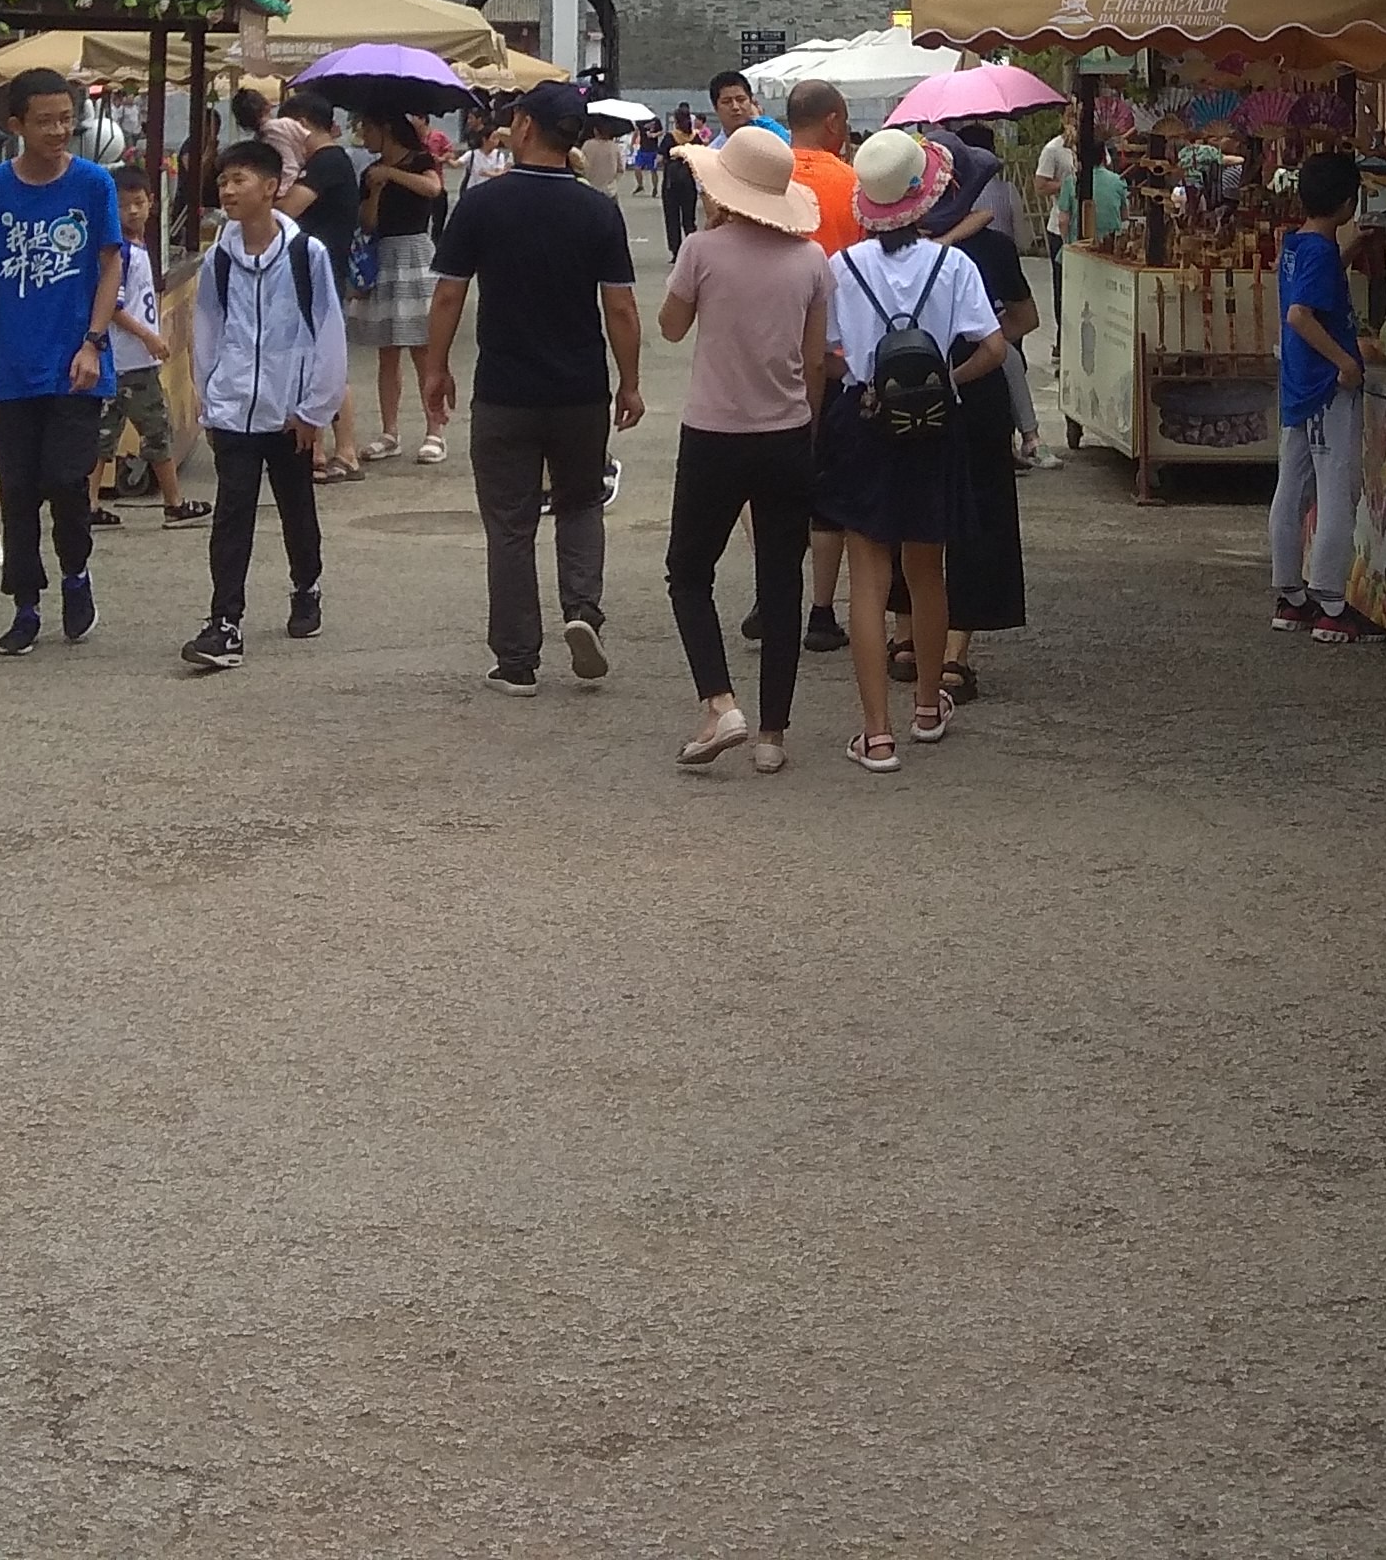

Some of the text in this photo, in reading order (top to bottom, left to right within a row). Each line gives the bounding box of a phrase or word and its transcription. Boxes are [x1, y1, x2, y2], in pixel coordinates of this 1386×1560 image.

[6, 220, 48, 252] 我是
[0, 251, 80, 299] 研学生
[142, 291, 155, 324] 8
